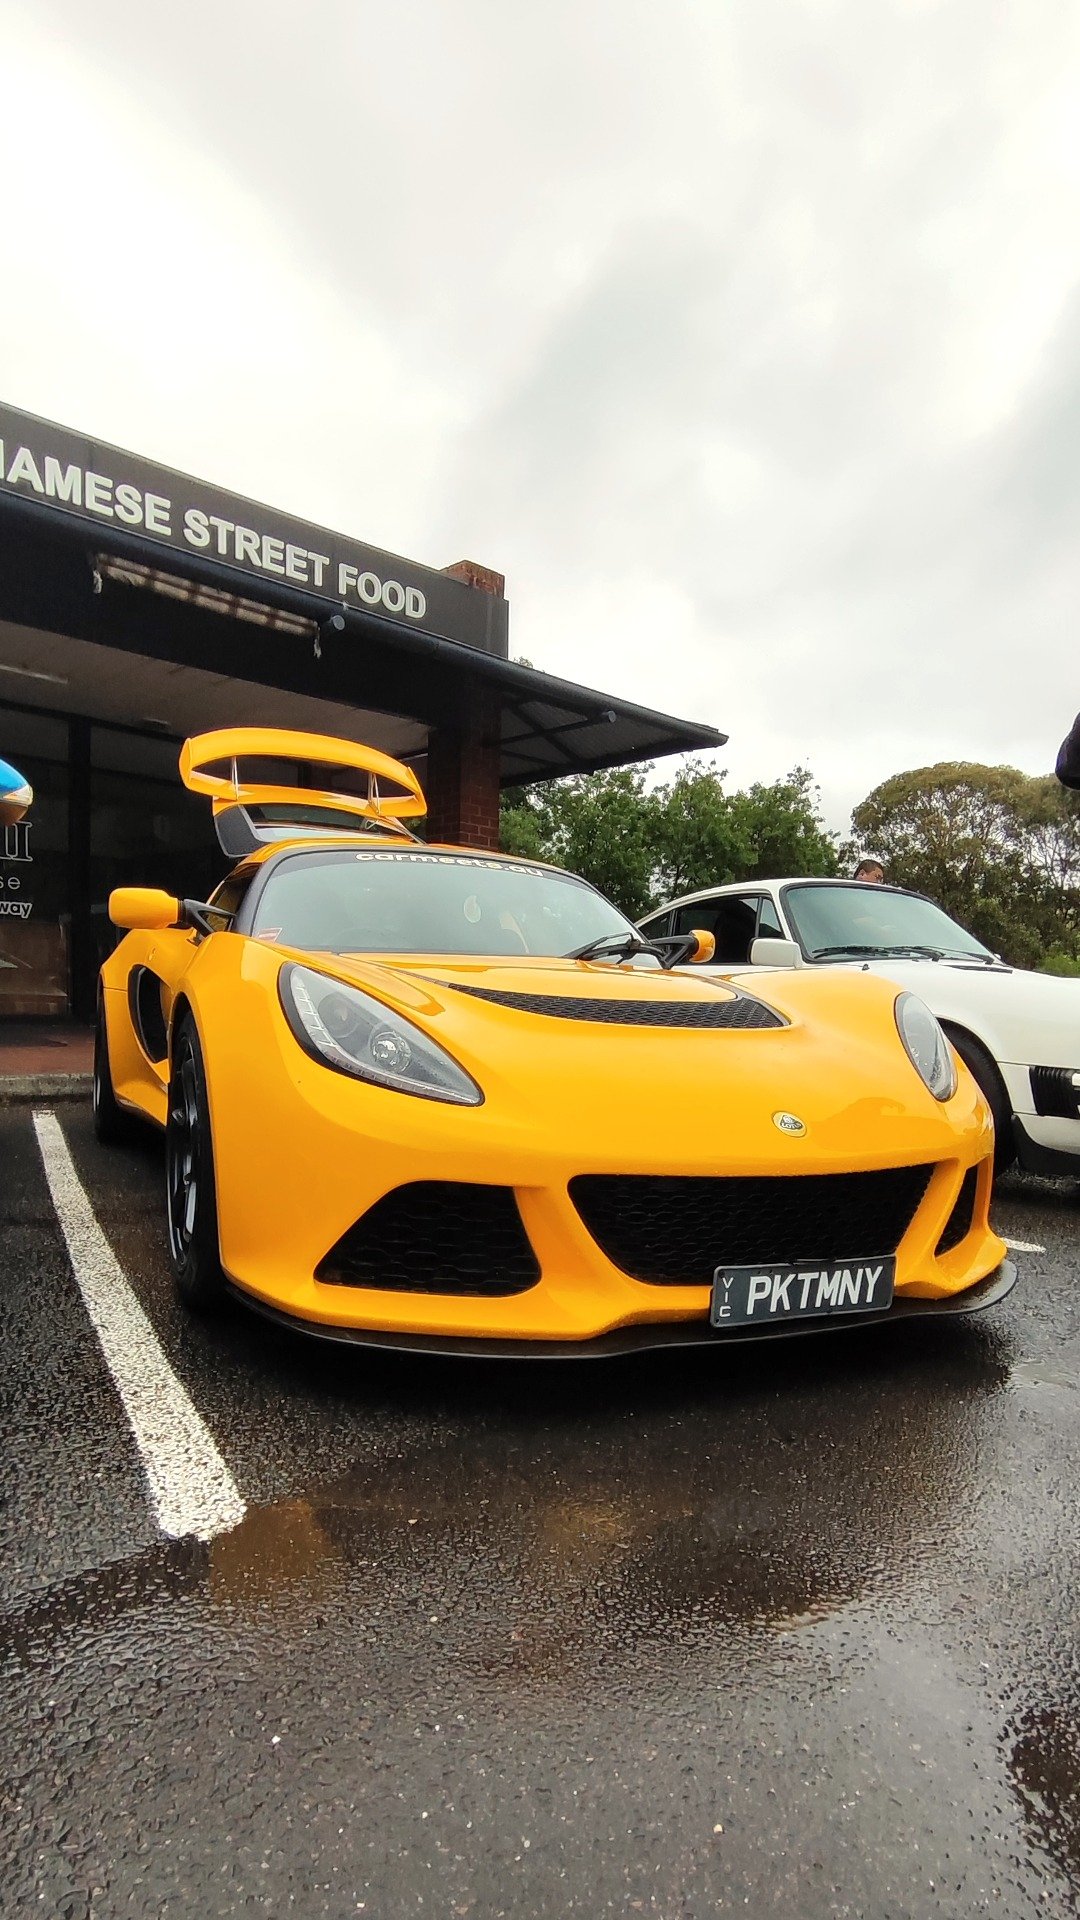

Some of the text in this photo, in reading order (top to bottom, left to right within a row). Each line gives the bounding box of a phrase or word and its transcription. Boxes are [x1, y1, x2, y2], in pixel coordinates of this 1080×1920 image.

[0, 438, 427, 620] AMESE STREET FOOD
[355, 852, 544, 877] carmeets.au
[719, 1276, 734, 1318] VIC
[746, 1265, 883, 1316] PKTMNY
